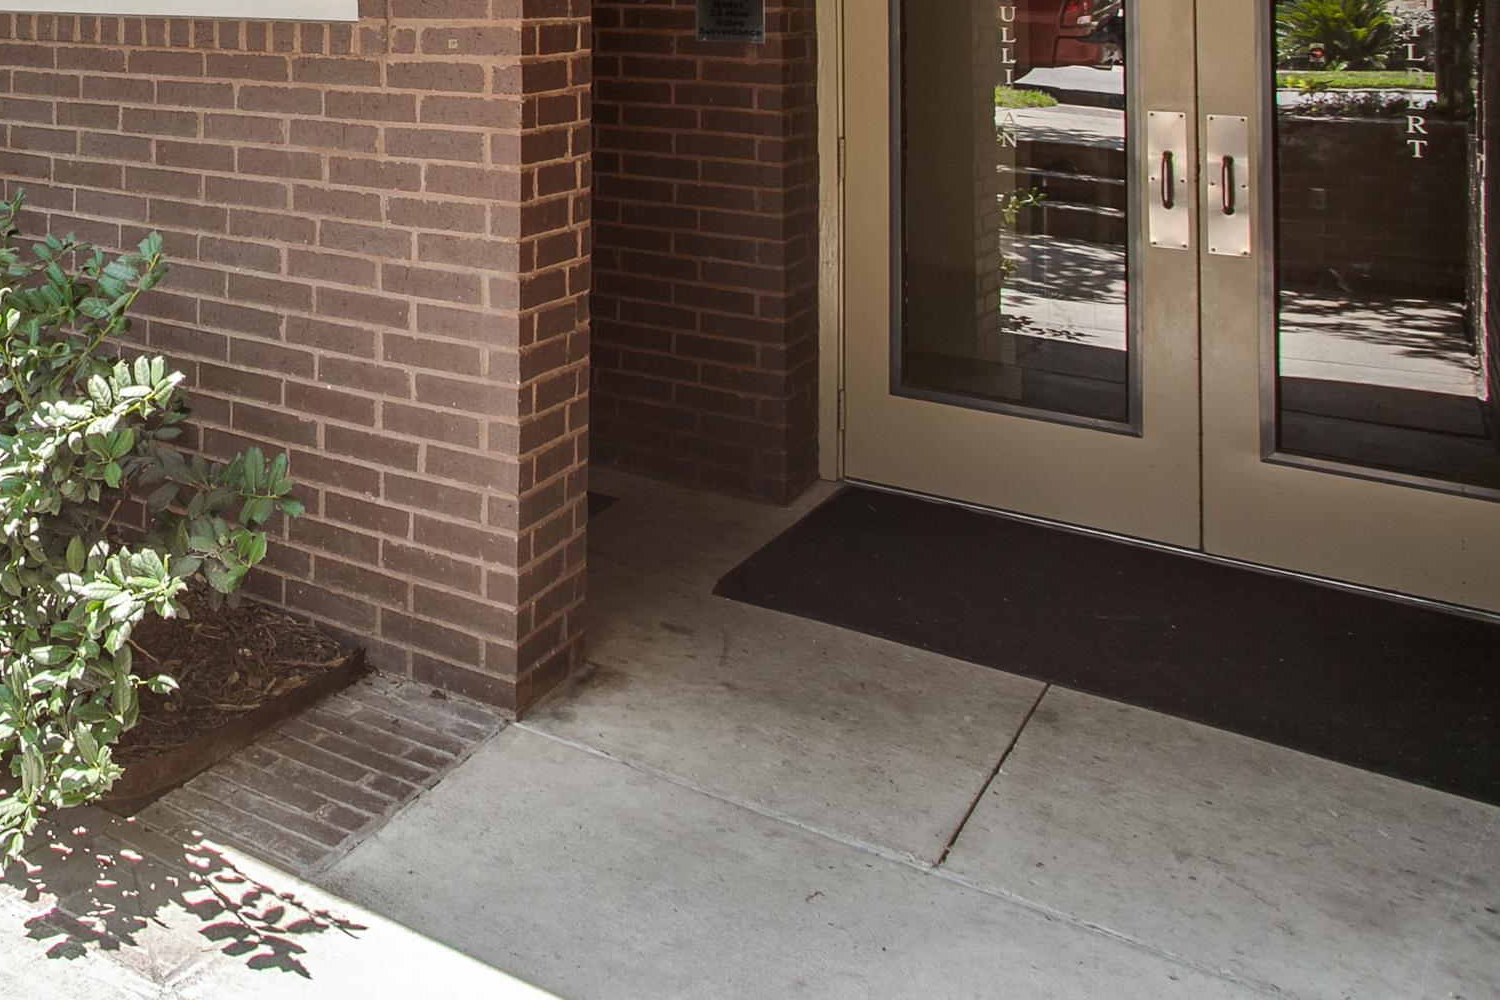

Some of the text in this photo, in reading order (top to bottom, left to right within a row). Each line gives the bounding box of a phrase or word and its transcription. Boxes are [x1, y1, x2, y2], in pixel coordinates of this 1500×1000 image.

[710, 9, 751, 17] 24 Hour
[715, 18, 745, 27] Video
[698, 26, 762, 36] Surveillance
